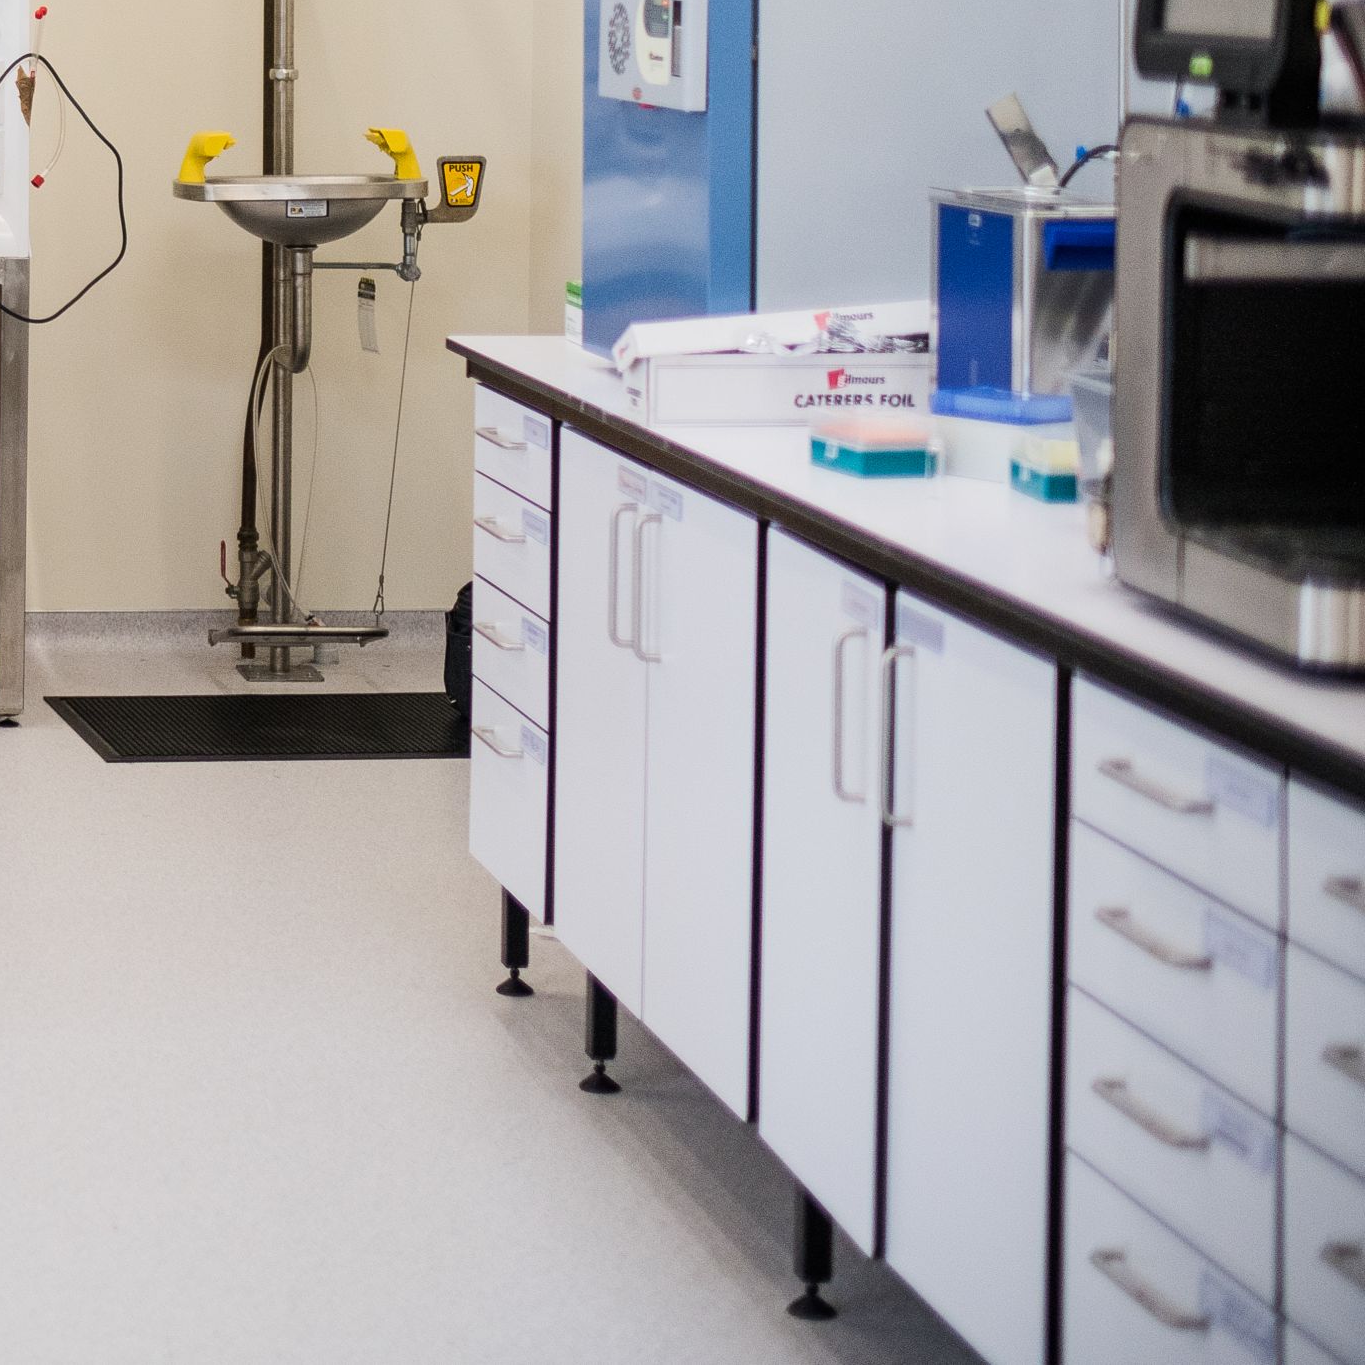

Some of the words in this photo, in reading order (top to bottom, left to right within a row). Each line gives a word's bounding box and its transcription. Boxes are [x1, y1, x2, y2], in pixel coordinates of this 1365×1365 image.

[449, 164, 474, 173] PUSH
[794, 394, 873, 409] CATERERS
[880, 394, 916, 408] FOIL
